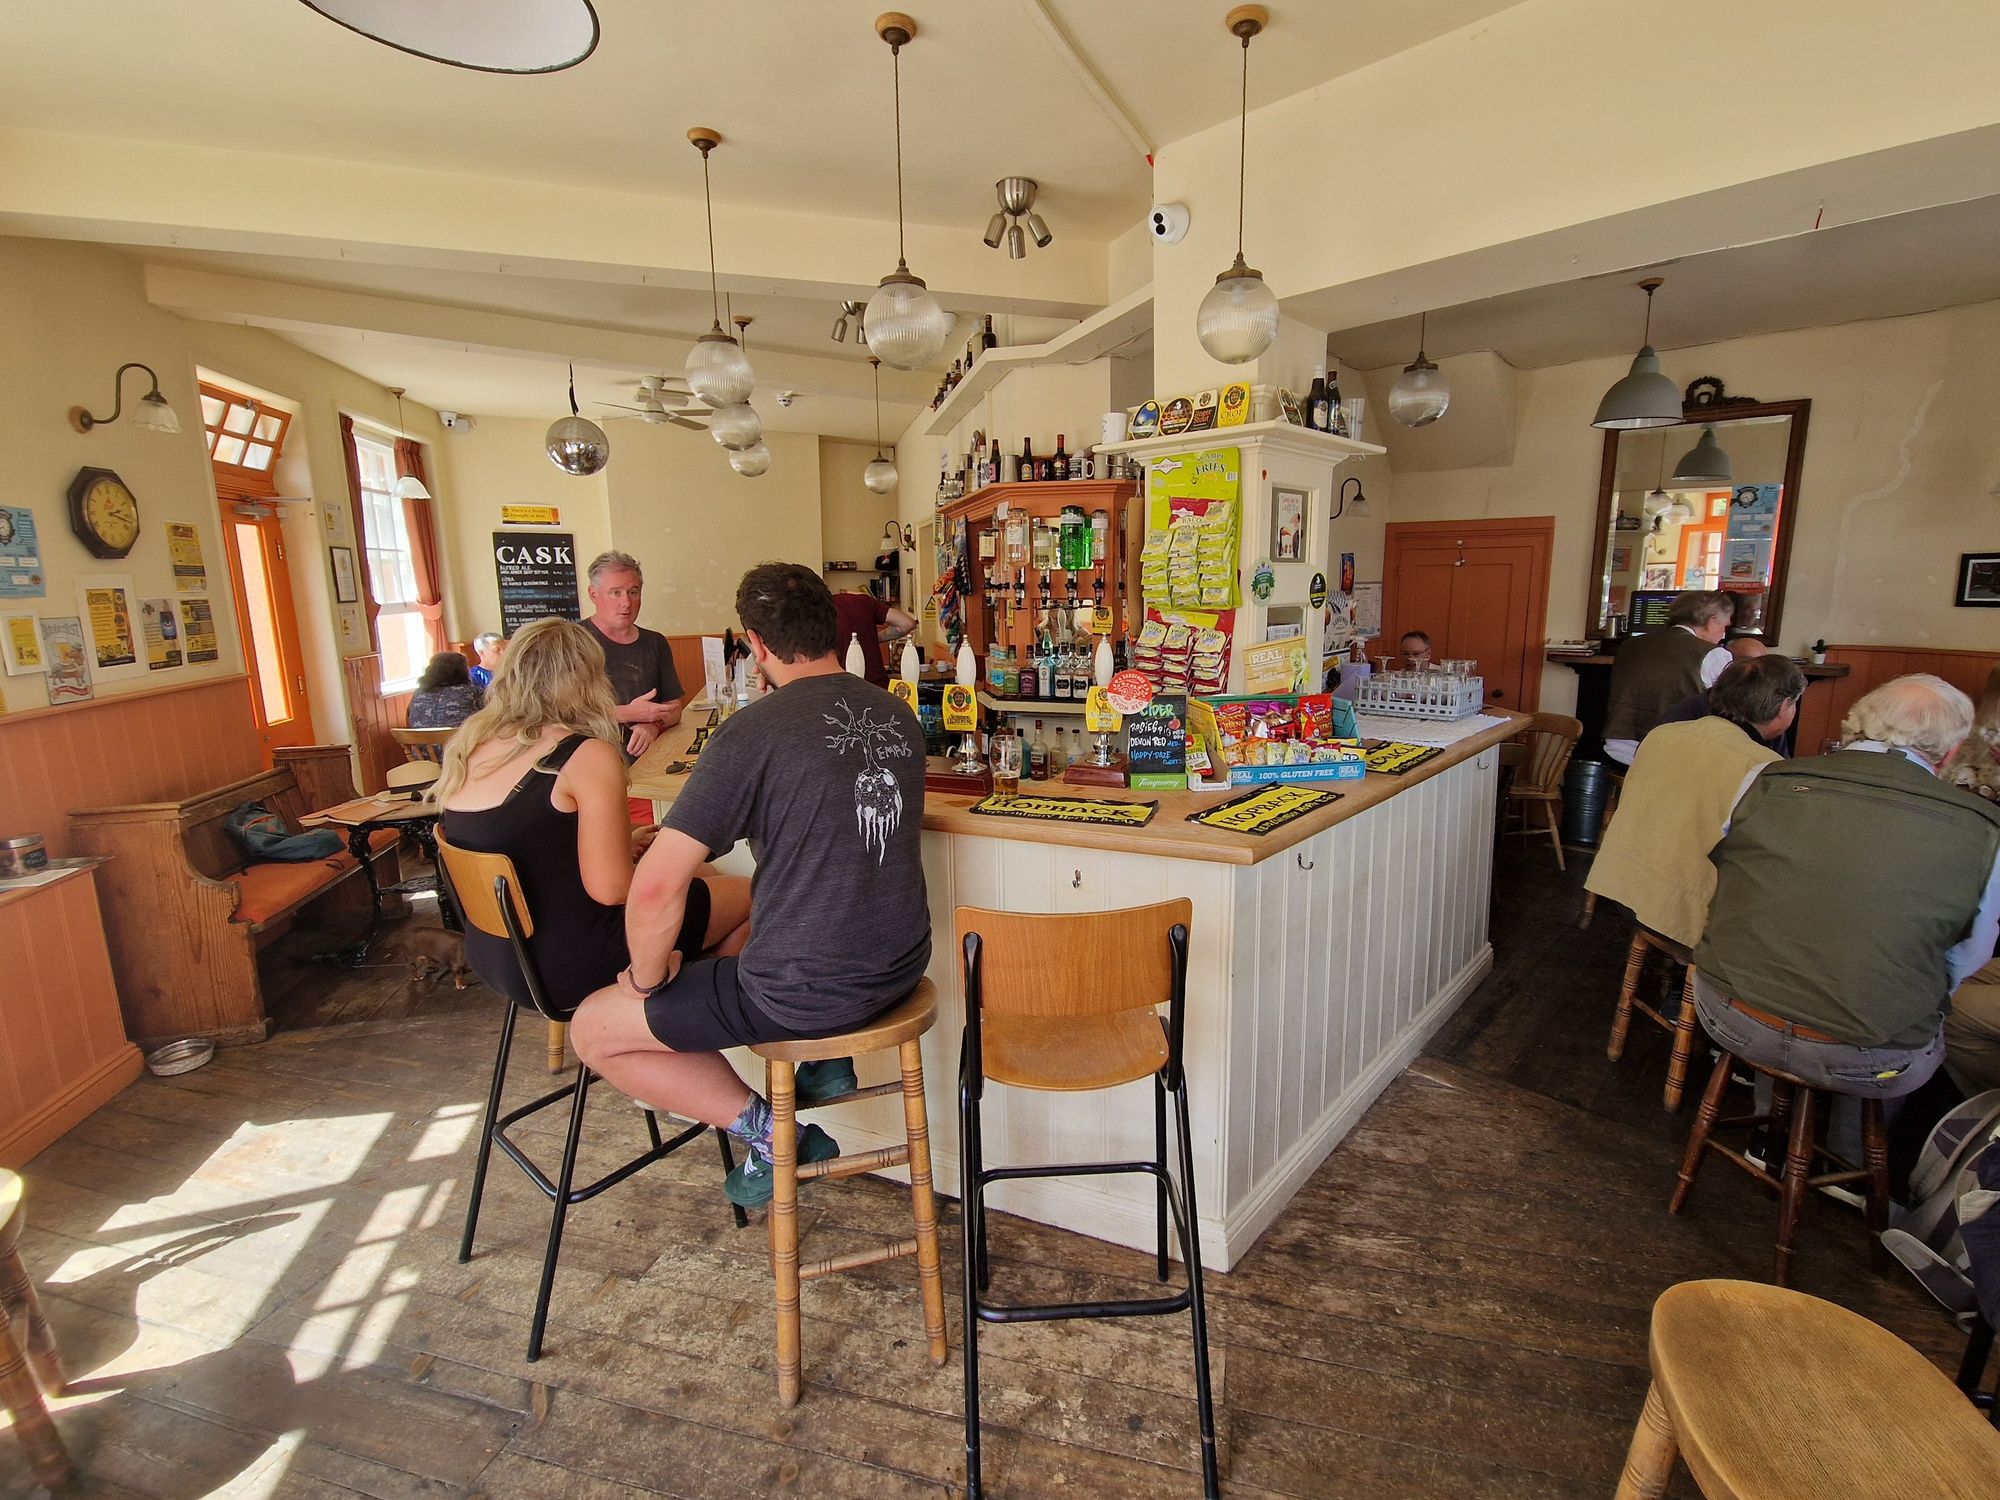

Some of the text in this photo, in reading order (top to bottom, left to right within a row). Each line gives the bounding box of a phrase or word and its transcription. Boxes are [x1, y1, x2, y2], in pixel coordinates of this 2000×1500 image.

[1220, 409, 1244, 418] CROP
[1195, 462, 1226, 475] FRIES
[496, 546, 573, 565] CASK
[1252, 649, 1283, 664] REAL
[1110, 695, 1144, 711] DEVON RED
[1140, 701, 1175, 717] CIDER
[1130, 736, 1151, 747] DEVON
[1152, 736, 1167, 747] RED
[1343, 753, 1358, 761] KP
[1232, 771, 1253, 779] REAL
[1258, 770, 1280, 779] 100%
[1280, 770, 1313, 779] GLUTEN
[1314, 768, 1335, 776] FREE
[1138, 777, 1180, 788] Tanqueray
